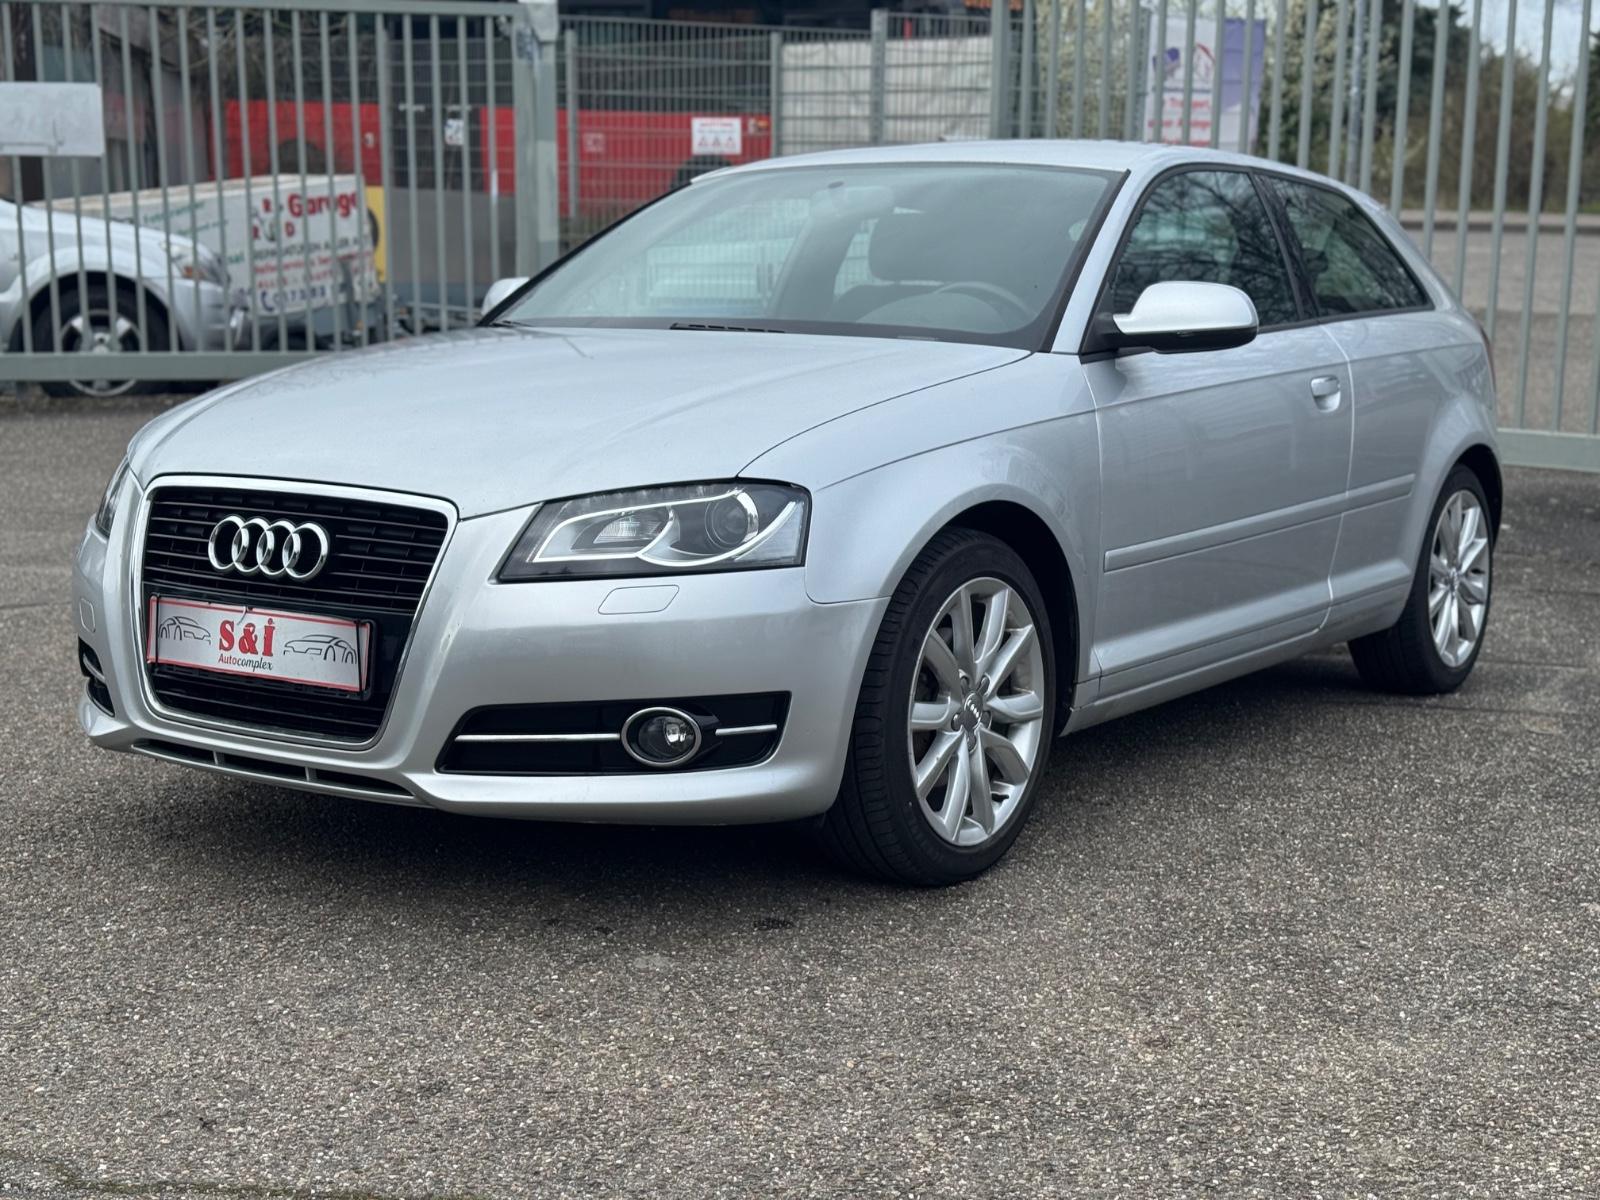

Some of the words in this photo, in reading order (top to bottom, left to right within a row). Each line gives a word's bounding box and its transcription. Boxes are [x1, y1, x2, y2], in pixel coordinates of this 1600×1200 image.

[288, 193, 358, 218] Garge
[219, 618, 275, 656] S&i
[218, 653, 273, 672] Autocomplex
